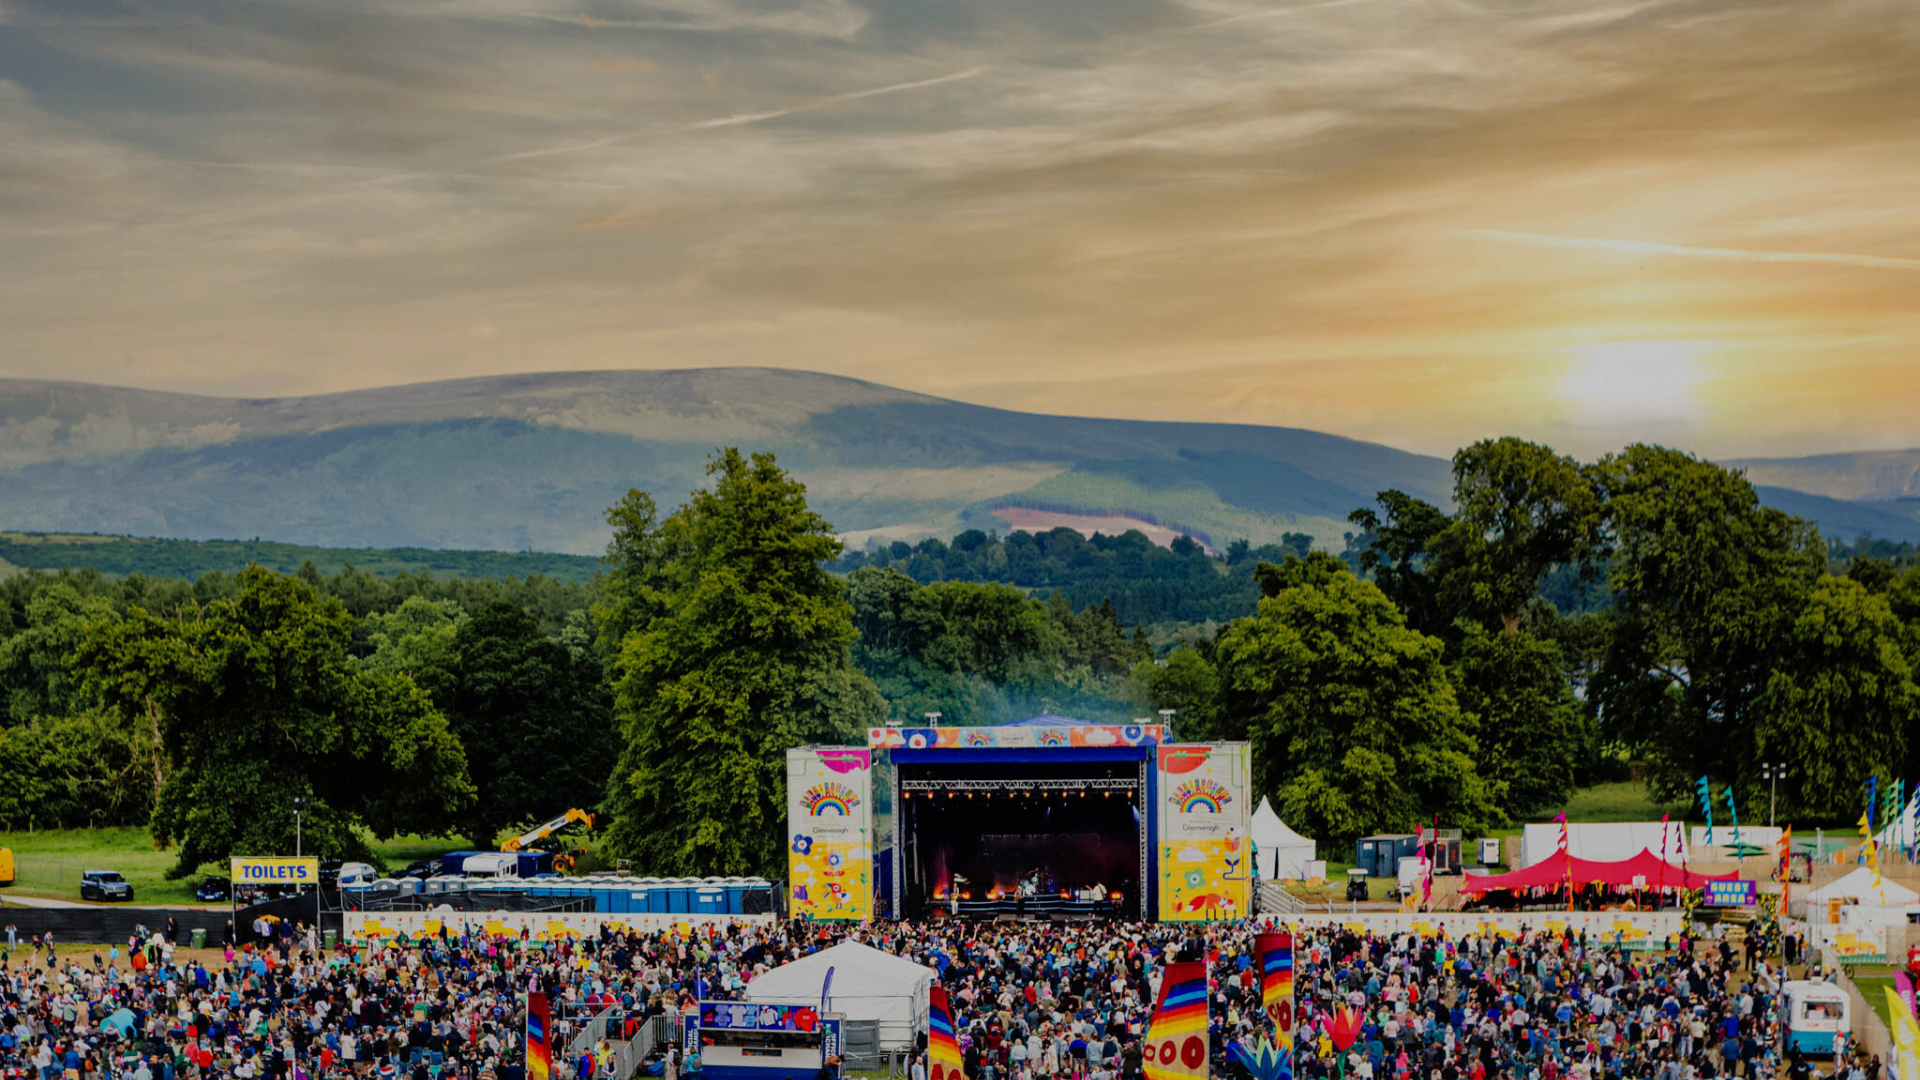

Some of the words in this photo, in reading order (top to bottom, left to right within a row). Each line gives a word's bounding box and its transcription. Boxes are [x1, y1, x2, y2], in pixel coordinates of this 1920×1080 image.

[242, 866, 307, 879] TOILETS
[1711, 882, 1749, 892] GUEST
[1715, 894, 1745, 903] AREA
